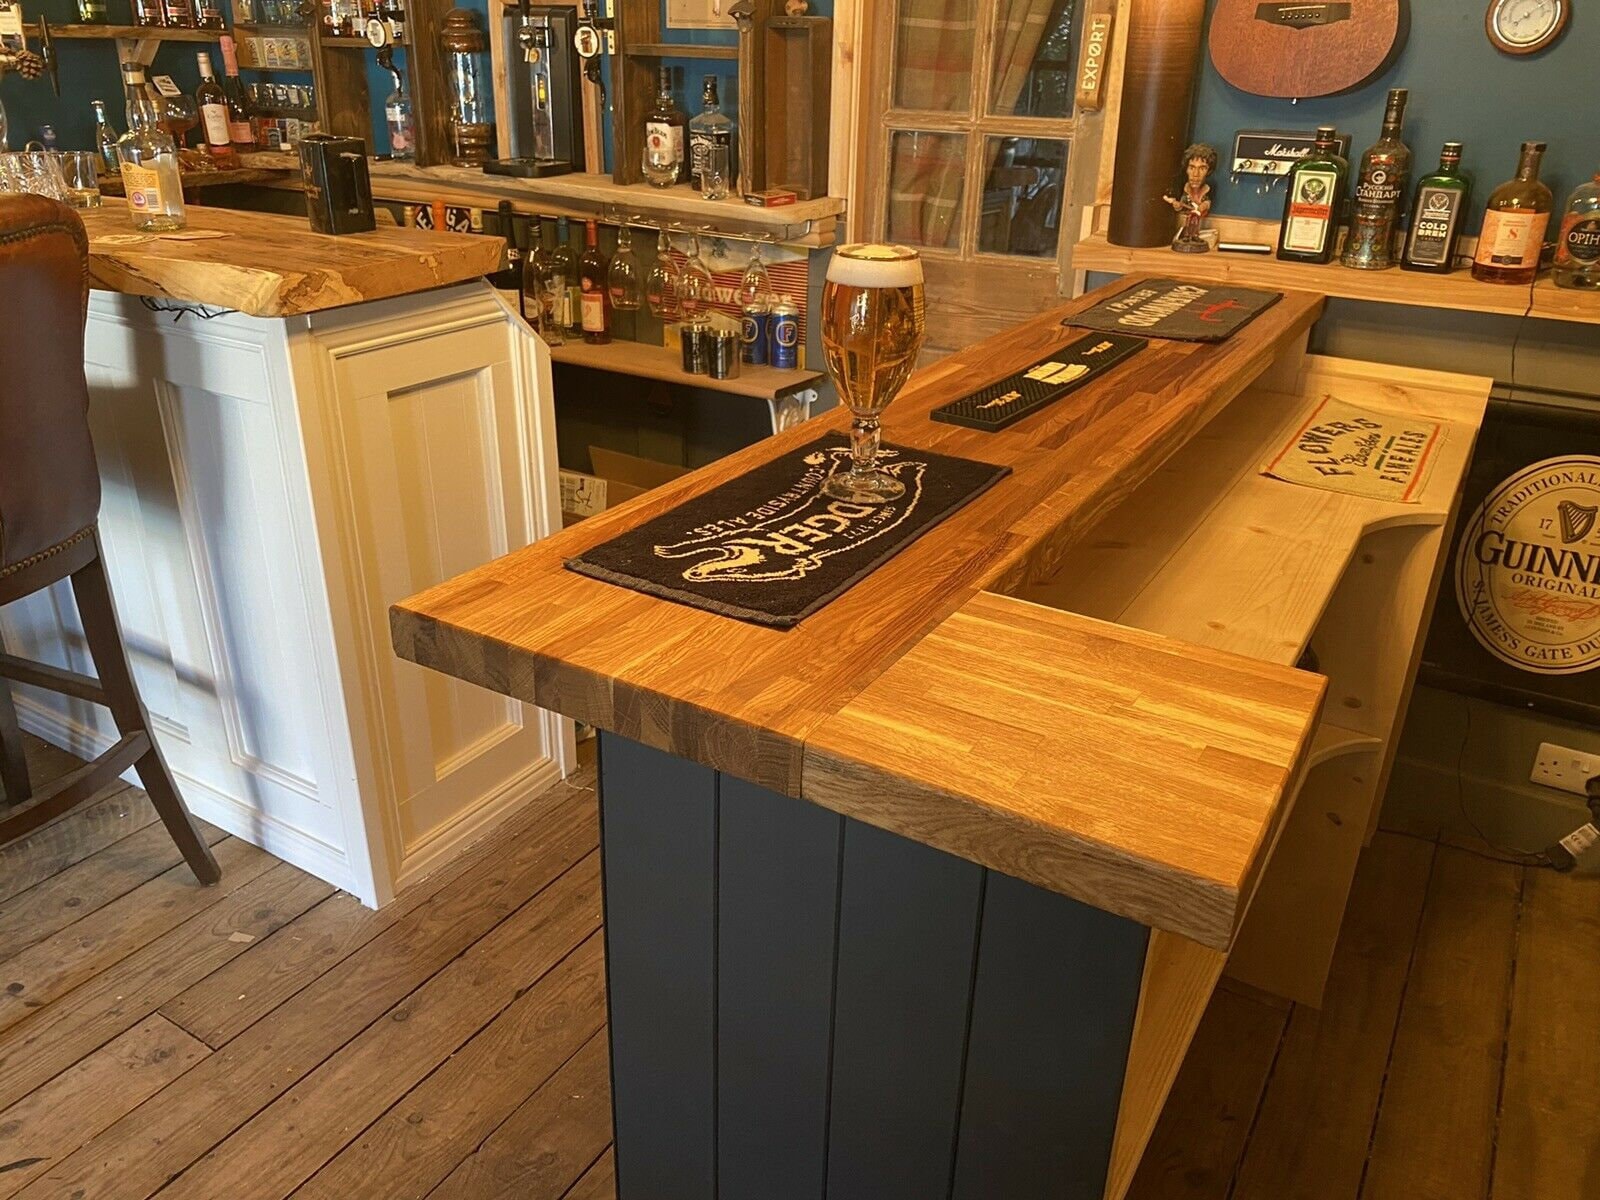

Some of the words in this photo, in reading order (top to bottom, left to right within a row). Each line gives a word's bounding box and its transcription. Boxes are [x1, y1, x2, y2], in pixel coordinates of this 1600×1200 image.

[1264, 143, 1310, 158] Marshall
[1417, 229, 1447, 238] BREW
[1419, 221, 1448, 231] COLD
[782, 325, 793, 343] F
[1298, 418, 1383, 477] FLOWERS
[1395, 430, 1428, 453] ALES
[746, 467, 825, 520] COUNTRYSIDE
[1491, 471, 1600, 525] TRADITIONAL
[722, 483, 905, 555] ADGER
[1511, 573, 1600, 601] ORIGINAL
[1524, 645, 1574, 661] GATE
[1577, 633, 1600, 656] DU
